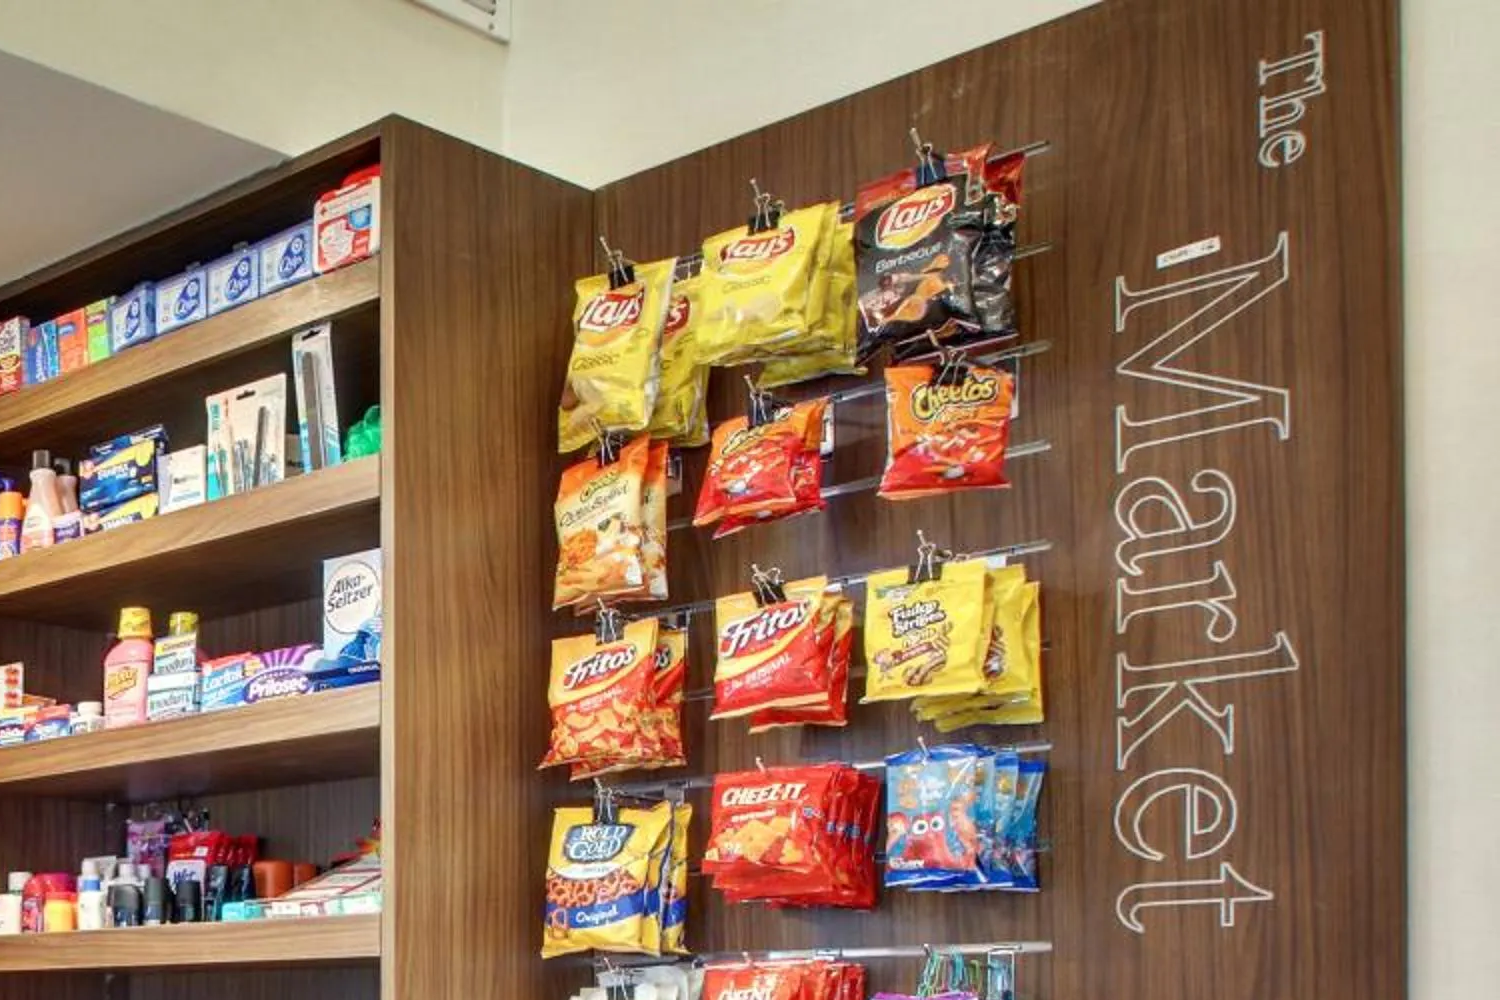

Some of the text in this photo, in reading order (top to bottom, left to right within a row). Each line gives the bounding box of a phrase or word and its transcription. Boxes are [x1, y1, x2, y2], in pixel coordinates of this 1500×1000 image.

[1257, 30, 1327, 168] The
[911, 376, 996, 419] Cheetos
[1114, 231, 1300, 934] Market
[720, 601, 810, 659] Fritos
[563, 646, 635, 689] Fritos
